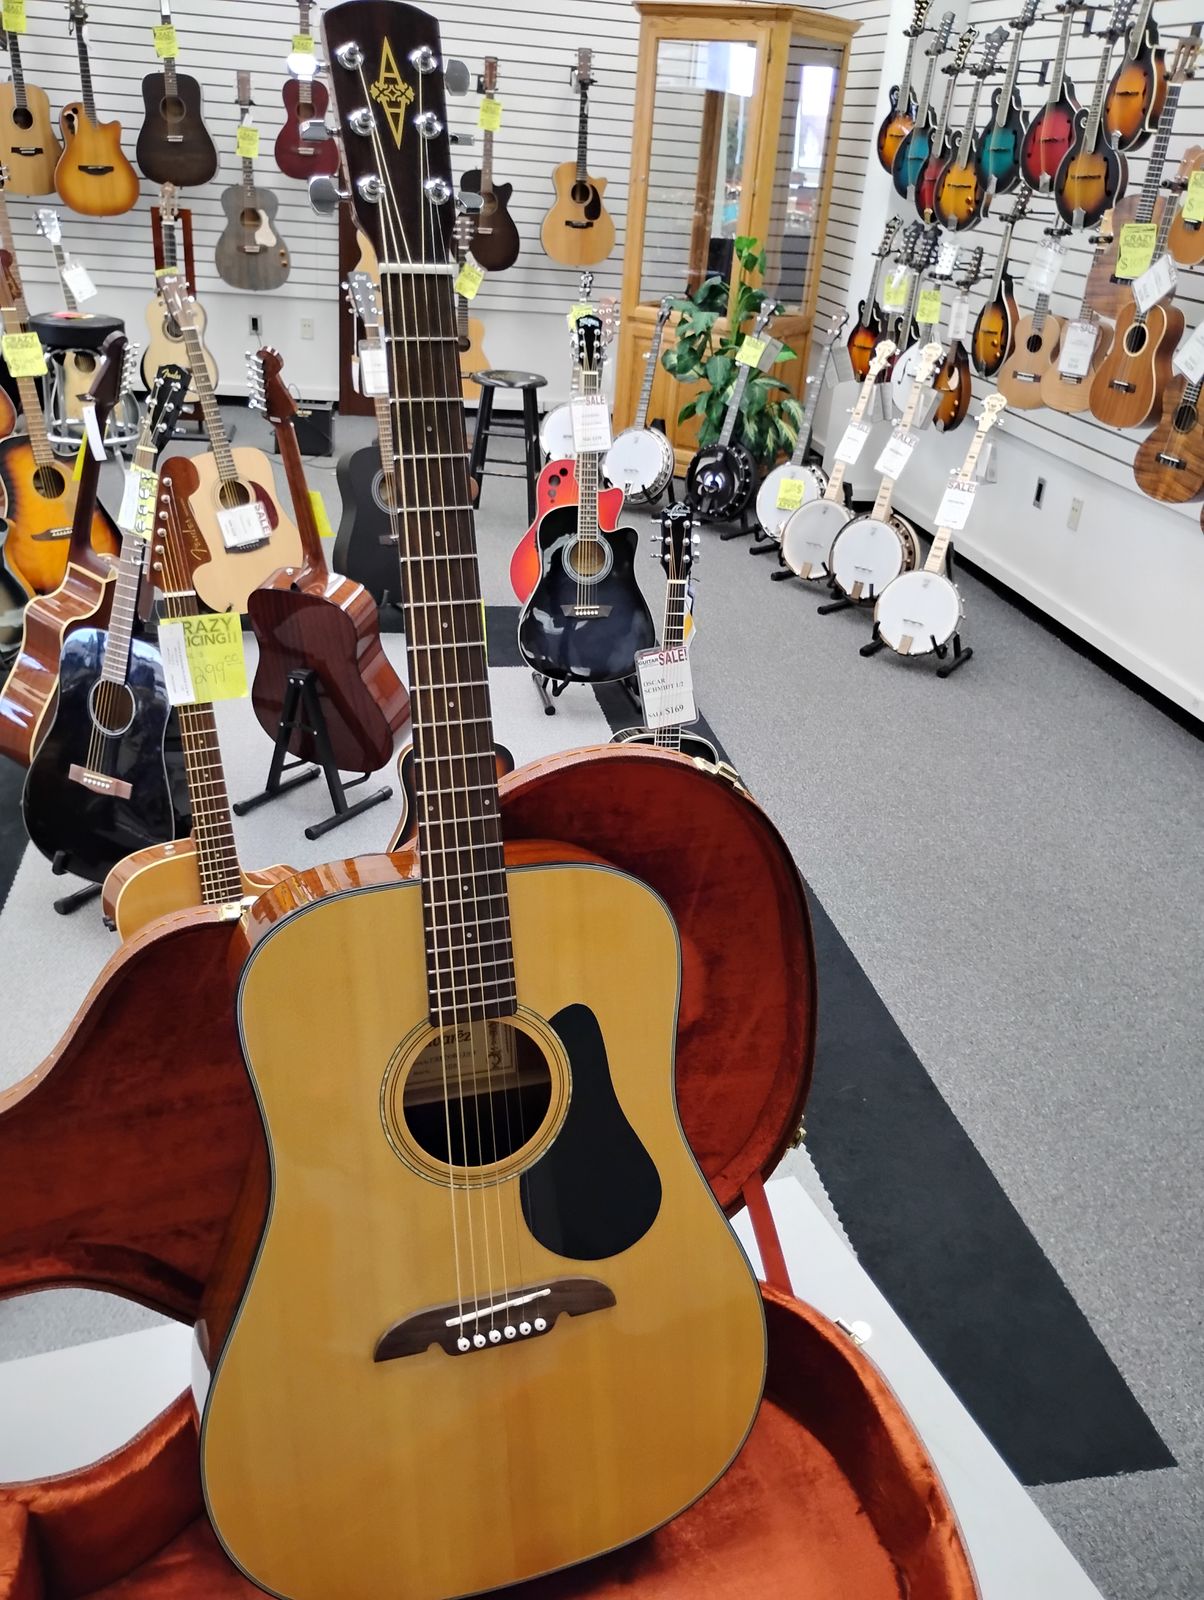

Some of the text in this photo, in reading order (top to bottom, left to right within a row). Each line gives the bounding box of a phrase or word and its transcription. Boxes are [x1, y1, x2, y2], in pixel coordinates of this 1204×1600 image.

[182, 518, 208, 561] Fender
[182, 617, 232, 635] RAZY
[186, 632, 237, 648] ICING!!
[658, 649, 688, 666] SALE!
